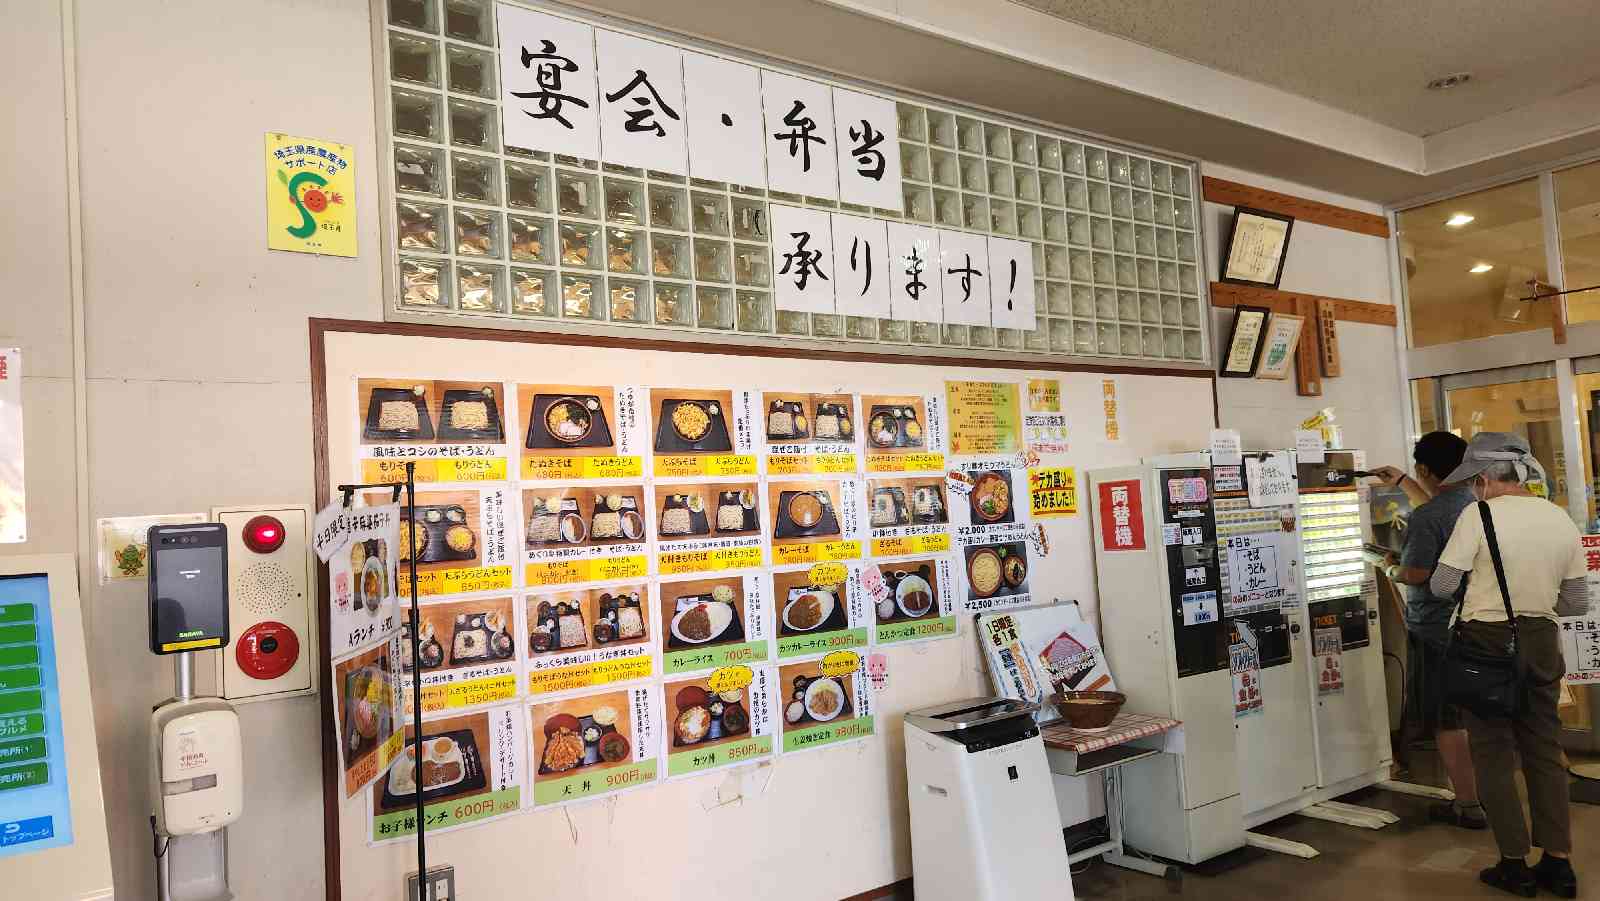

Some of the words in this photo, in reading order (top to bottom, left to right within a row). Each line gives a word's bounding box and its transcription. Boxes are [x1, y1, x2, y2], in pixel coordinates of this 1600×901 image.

[510, 39, 886, 182] 宴会・弁当
[1110, 486, 1135, 547] 両替機
[779, 639, 827, 654] カツカレーライス
[673, 654, 713, 668] カレーライス
[606, 769, 641, 786] 900円
[454, 799, 495, 820] 600円
[379, 811, 449, 834] お子様ンチ
